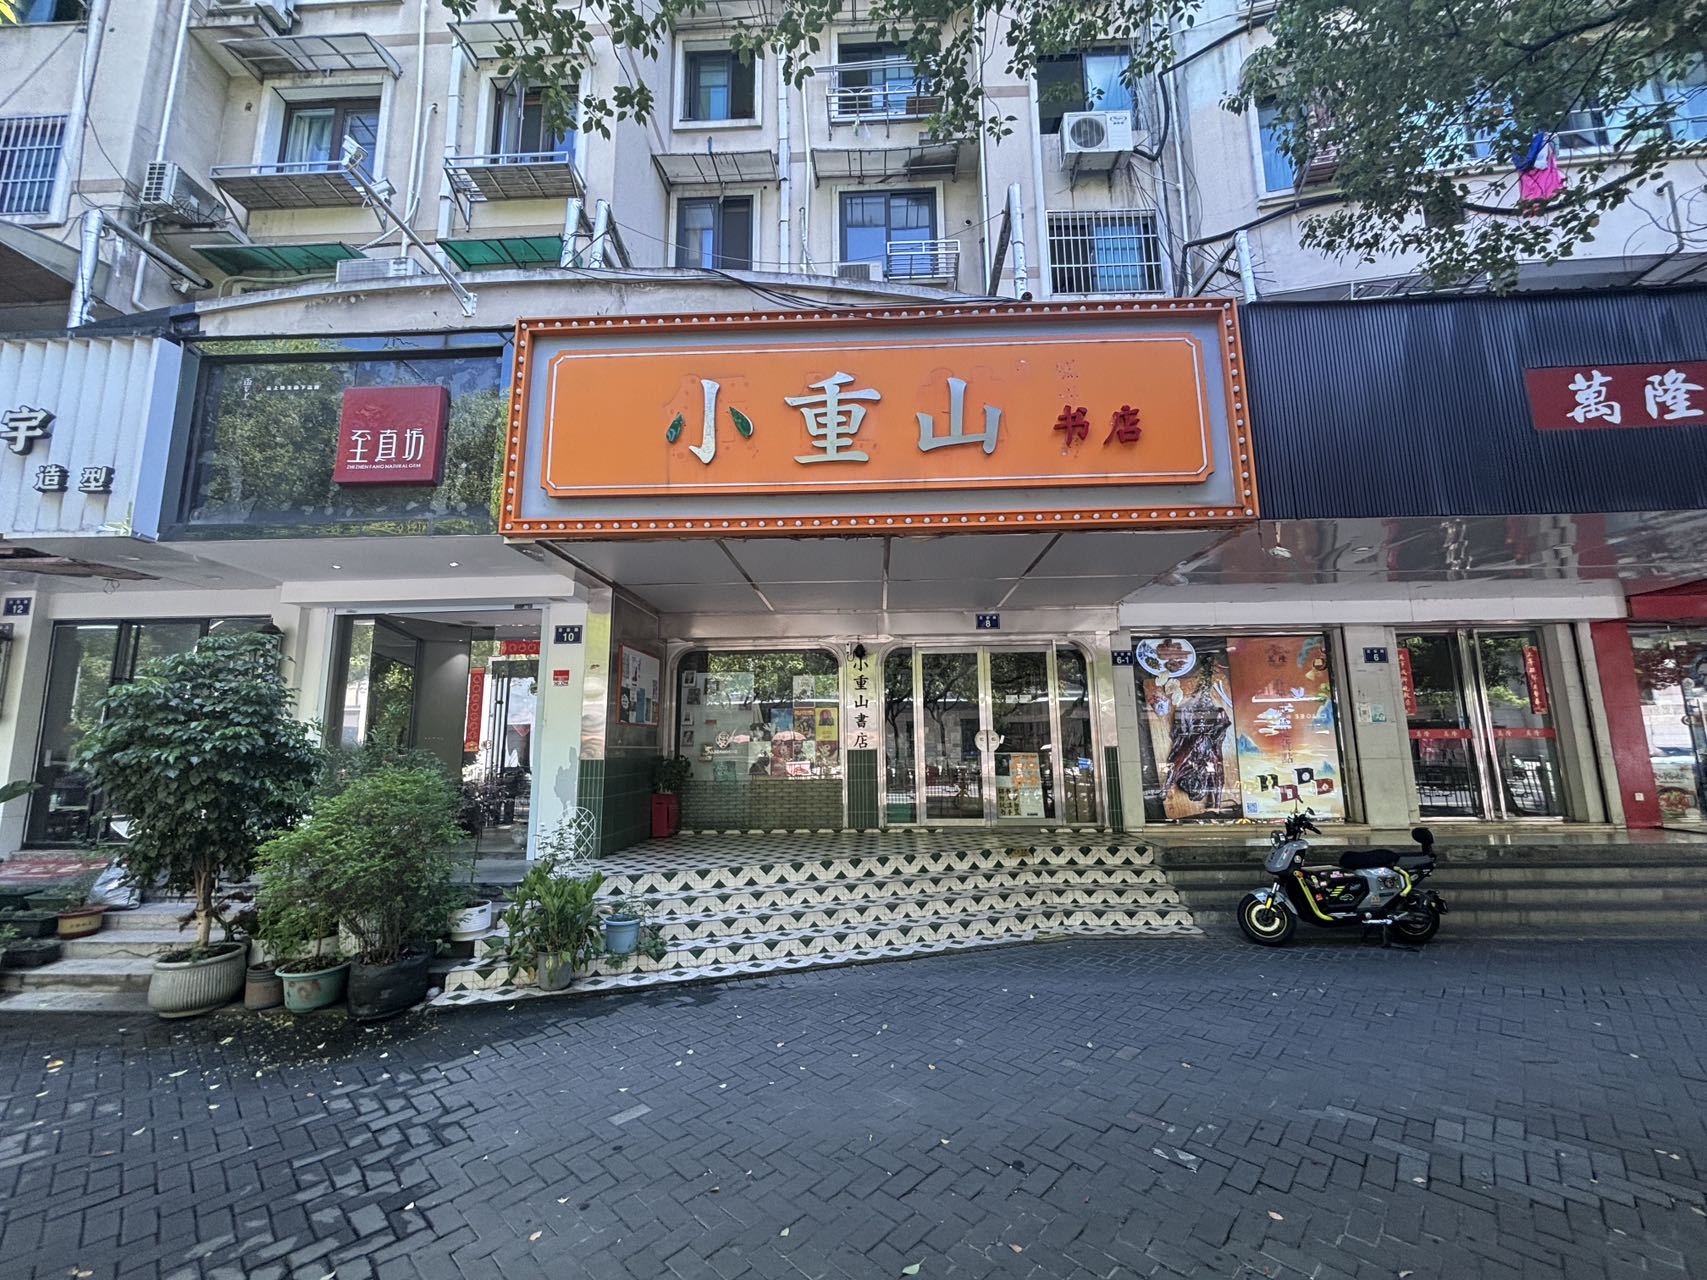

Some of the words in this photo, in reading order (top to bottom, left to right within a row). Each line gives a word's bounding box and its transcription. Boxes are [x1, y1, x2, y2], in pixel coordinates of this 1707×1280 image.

[1566, 369, 1704, 424] 萬隆
[666, 371, 1001, 464] 小重山
[1053, 405, 1142, 447] 书店
[0, 405, 54, 455] 宇
[33, 464, 114, 494] 造型
[13, 604, 24, 614] 12
[985, 620, 991, 628] 8
[563, 632, 574, 642] 10
[1116, 656, 1129, 664] 6-1
[1373, 653, 1380, 661] 6
[853, 658, 869, 748] 小重山書店
